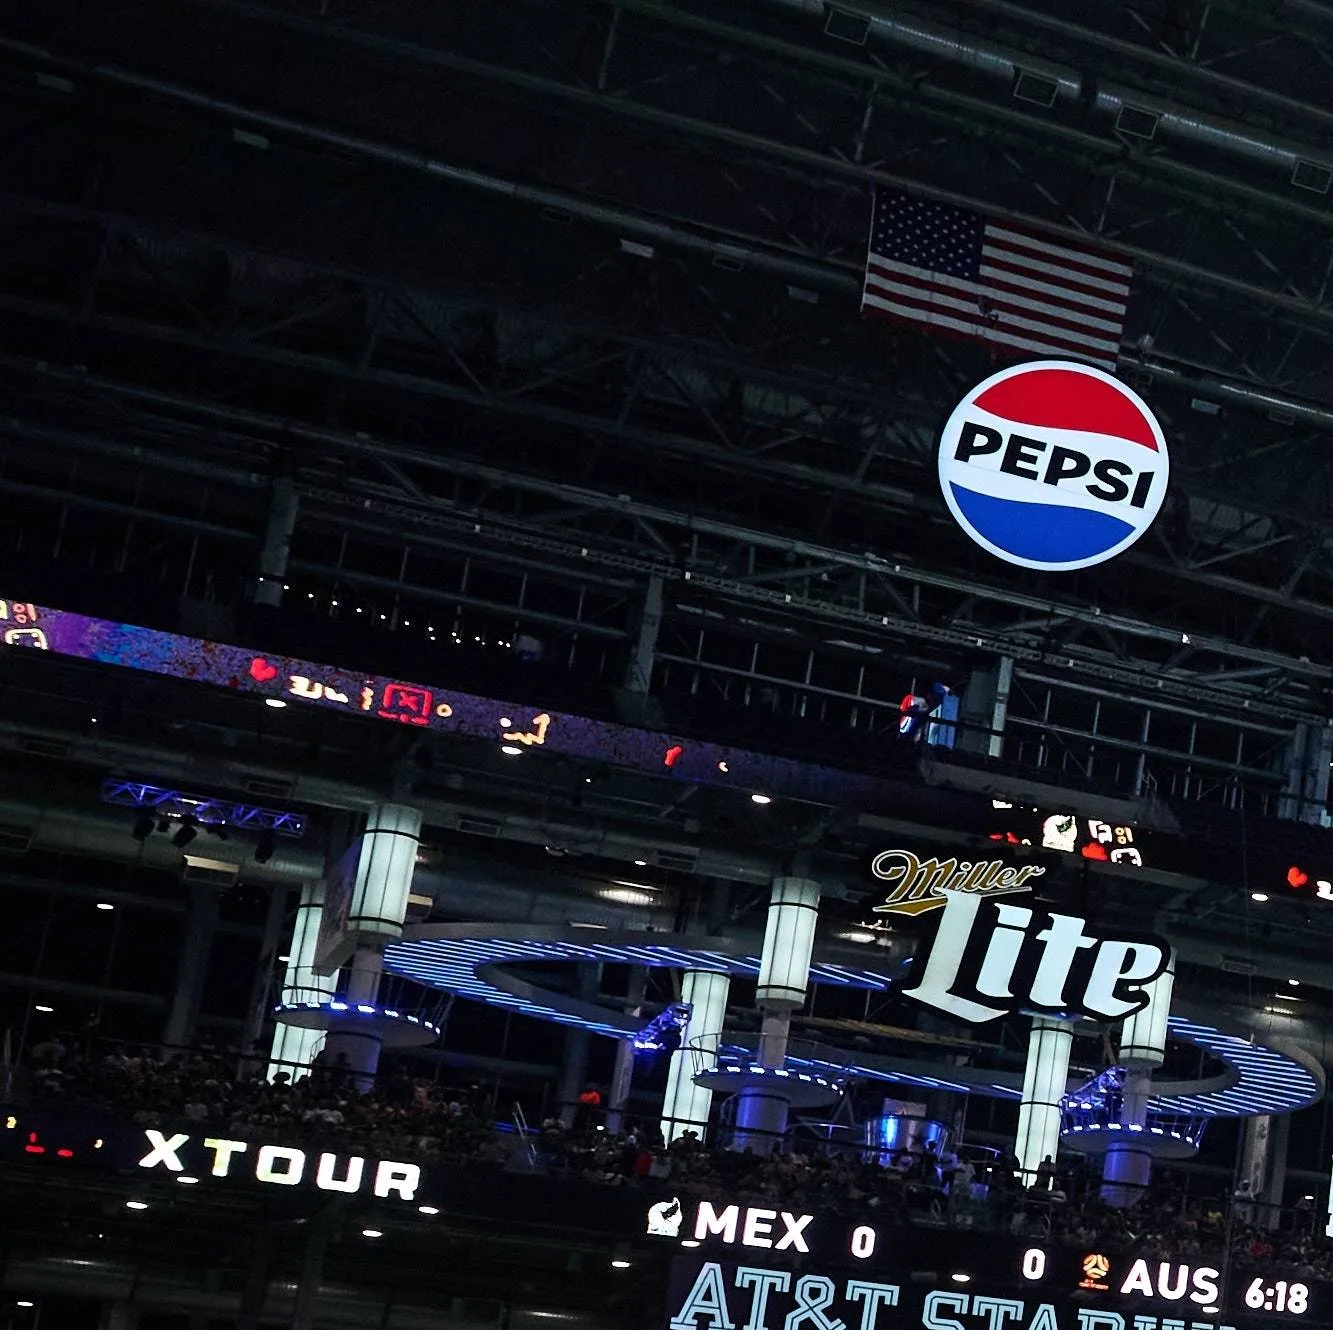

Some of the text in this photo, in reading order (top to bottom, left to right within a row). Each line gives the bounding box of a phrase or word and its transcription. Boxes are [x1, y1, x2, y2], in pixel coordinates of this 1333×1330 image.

[953, 421, 1155, 509] PEPSI
[872, 850, 1046, 907] Miller
[902, 887, 1164, 1022] Lite
[139, 1130, 420, 1201] XTOUR
[694, 1202, 1309, 1315] MEX 0 0 AUS 6:18
